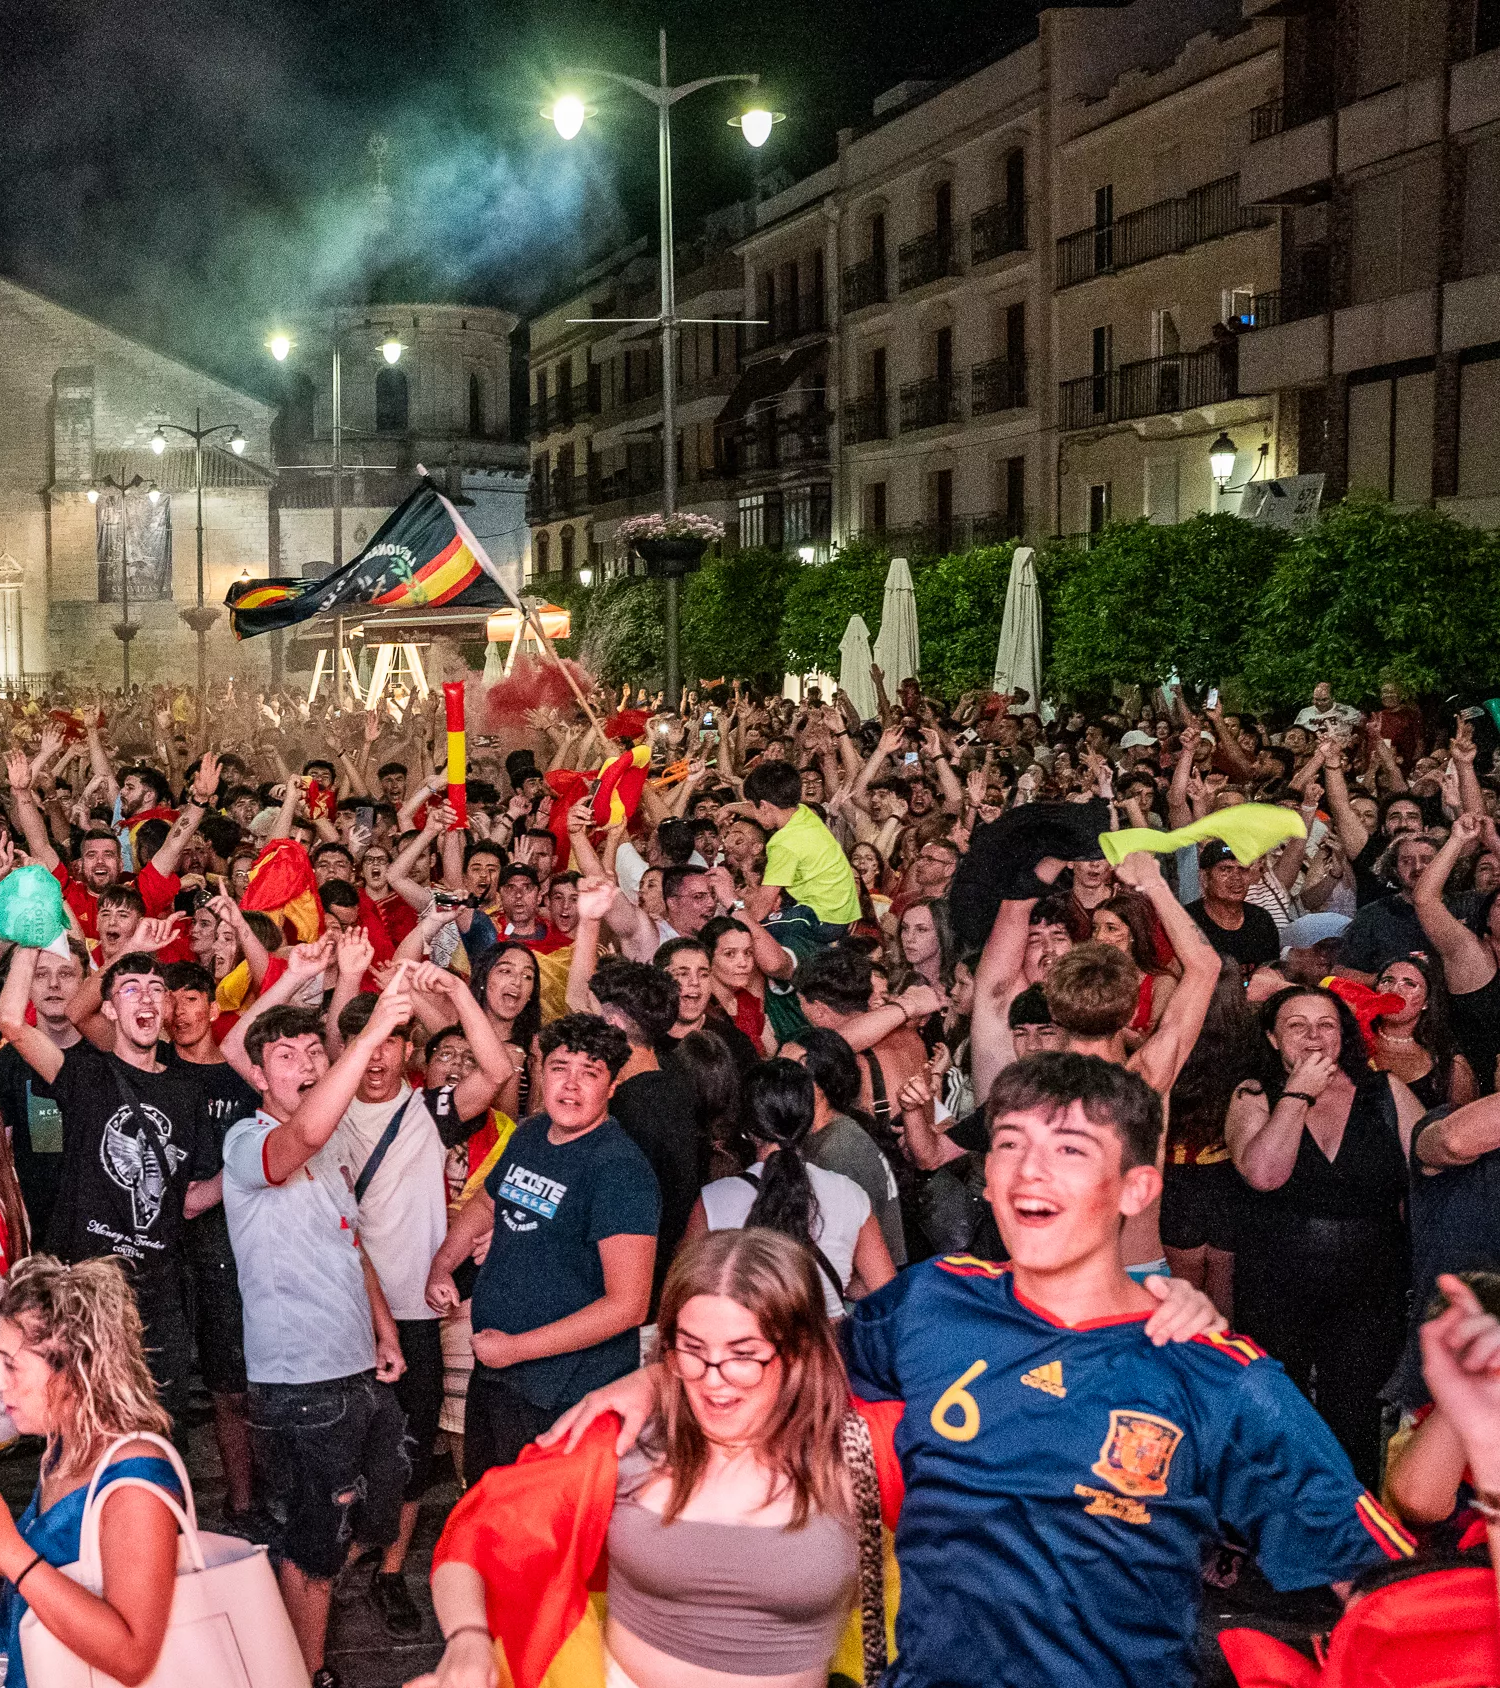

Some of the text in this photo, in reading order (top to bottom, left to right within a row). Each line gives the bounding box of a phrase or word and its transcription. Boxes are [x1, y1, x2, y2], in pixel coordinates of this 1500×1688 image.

[503, 1163, 568, 1205] LACOSTE
[86, 1219, 125, 1243] Money
[930, 1359, 988, 1442] 6
[1020, 1374, 1068, 1398] adidas
